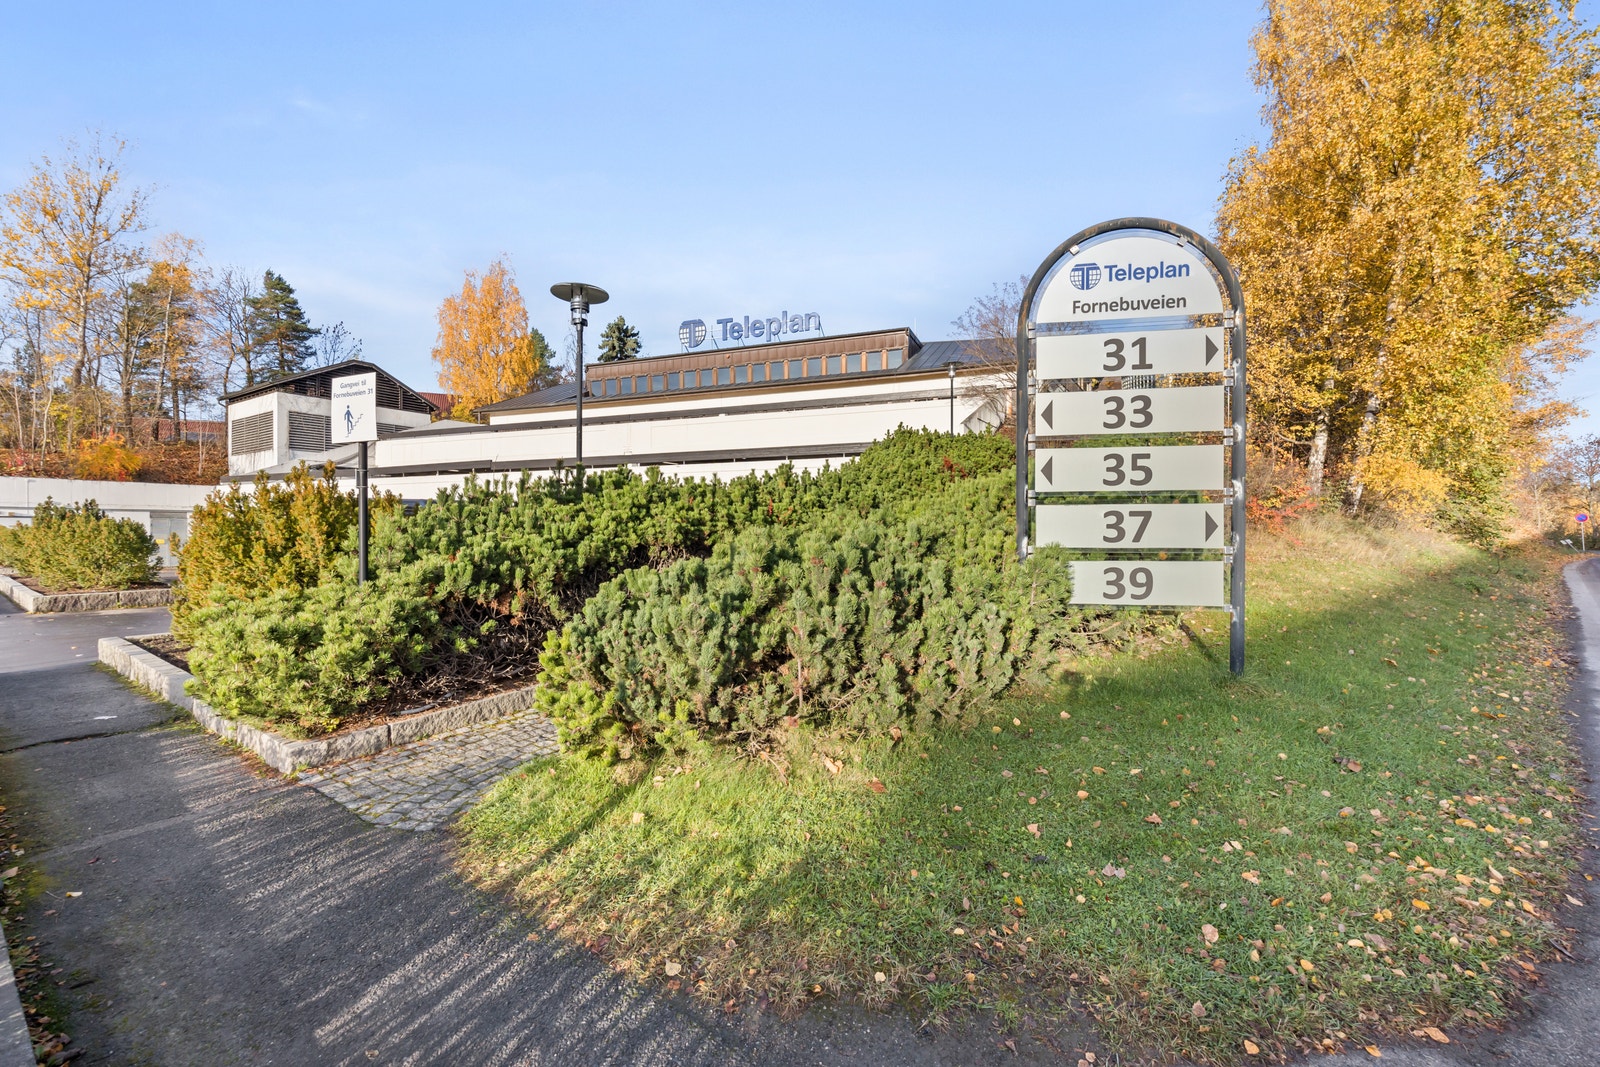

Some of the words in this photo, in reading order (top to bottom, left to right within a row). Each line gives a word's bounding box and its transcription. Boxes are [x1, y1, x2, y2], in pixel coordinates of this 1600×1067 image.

[1104, 261, 1190, 283] Teleplan
[1072, 295, 1187, 314] Fornebuveien
[716, 310, 820, 342] Teleplan
[1102, 337, 1153, 372] 31
[333, 390, 366, 398] Fornebuveien
[340, 381, 359, 389] Gangvei
[1102, 394, 1154, 429] 33
[1102, 453, 1153, 487] 35
[1102, 510, 1153, 543] 37
[1102, 566, 1154, 600] 39
